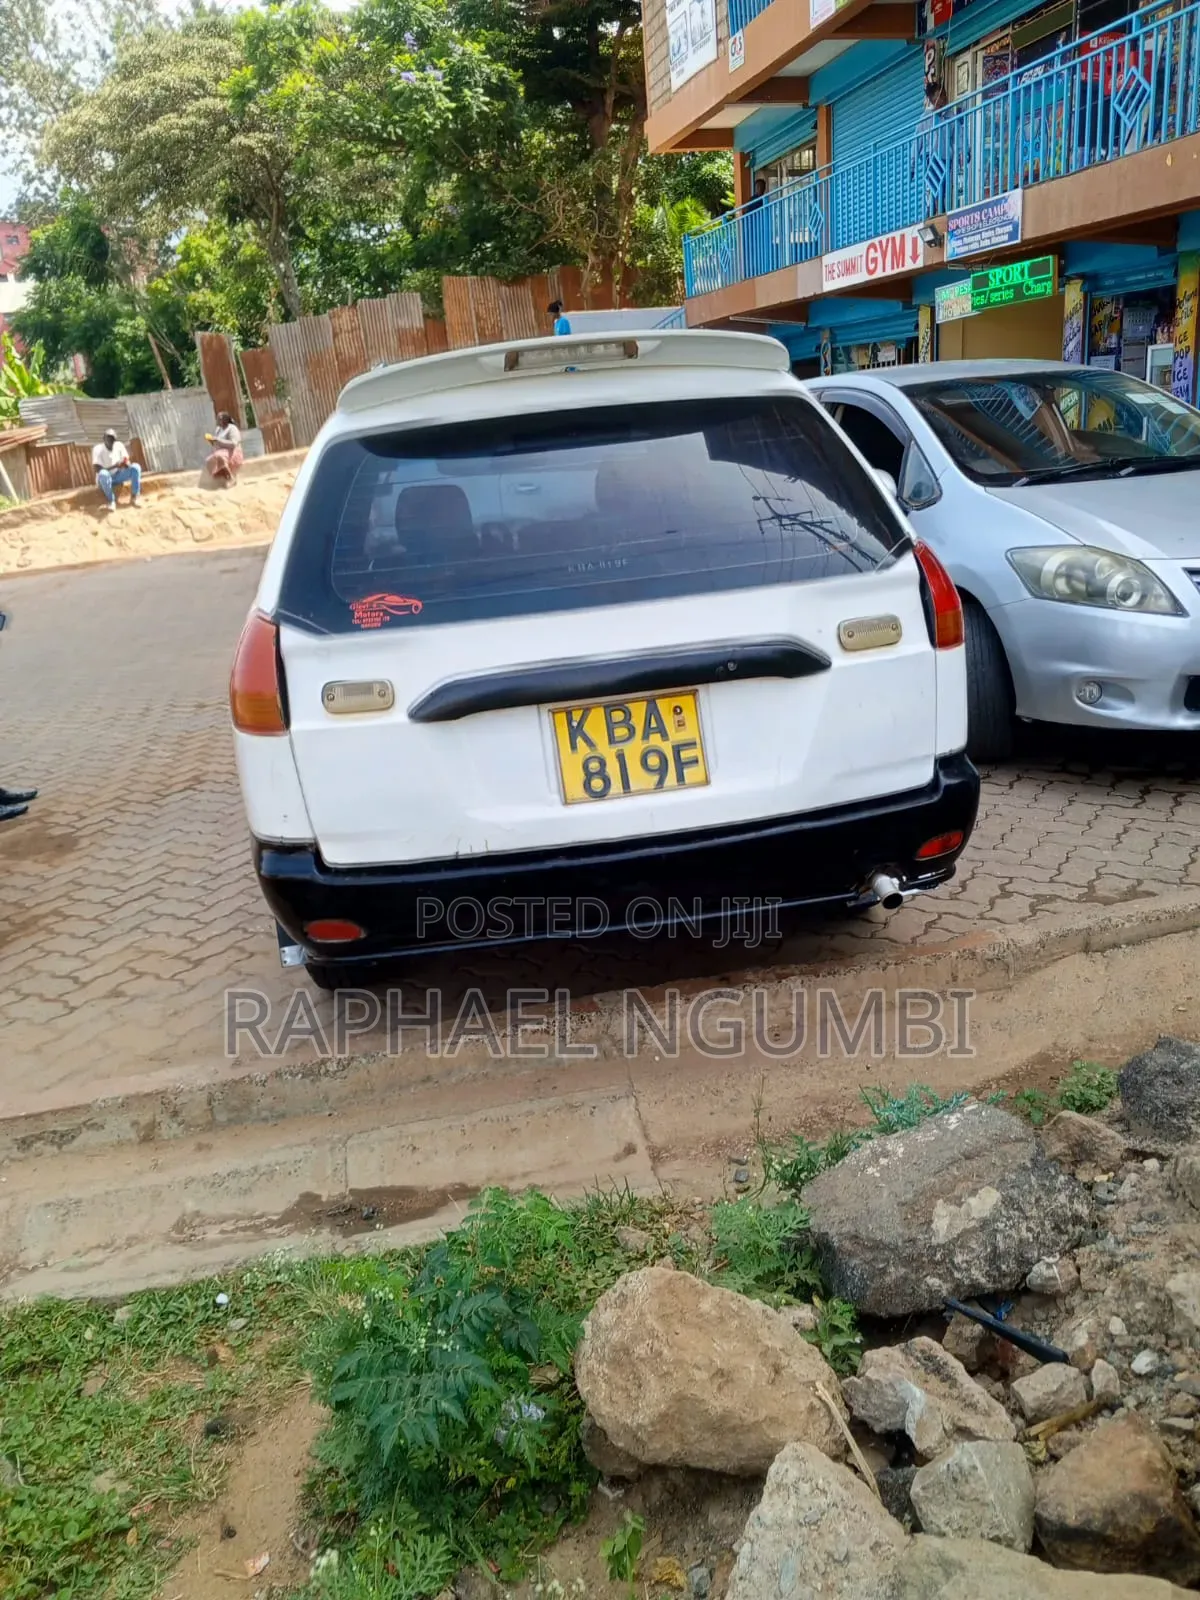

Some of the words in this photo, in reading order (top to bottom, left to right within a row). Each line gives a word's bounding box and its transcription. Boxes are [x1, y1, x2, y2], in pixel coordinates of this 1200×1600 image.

[948, 211, 980, 231] SPORTS
[824, 262, 836, 282] THE
[836, 254, 864, 279] SUMMIT
[865, 233, 907, 276] GYM
[988, 260, 1031, 289] SPORT
[1174, 331, 1189, 347] ICE
[1172, 367, 1188, 383] ICE
[565, 699, 670, 753] KBA
[582, 740, 699, 799] 819F
